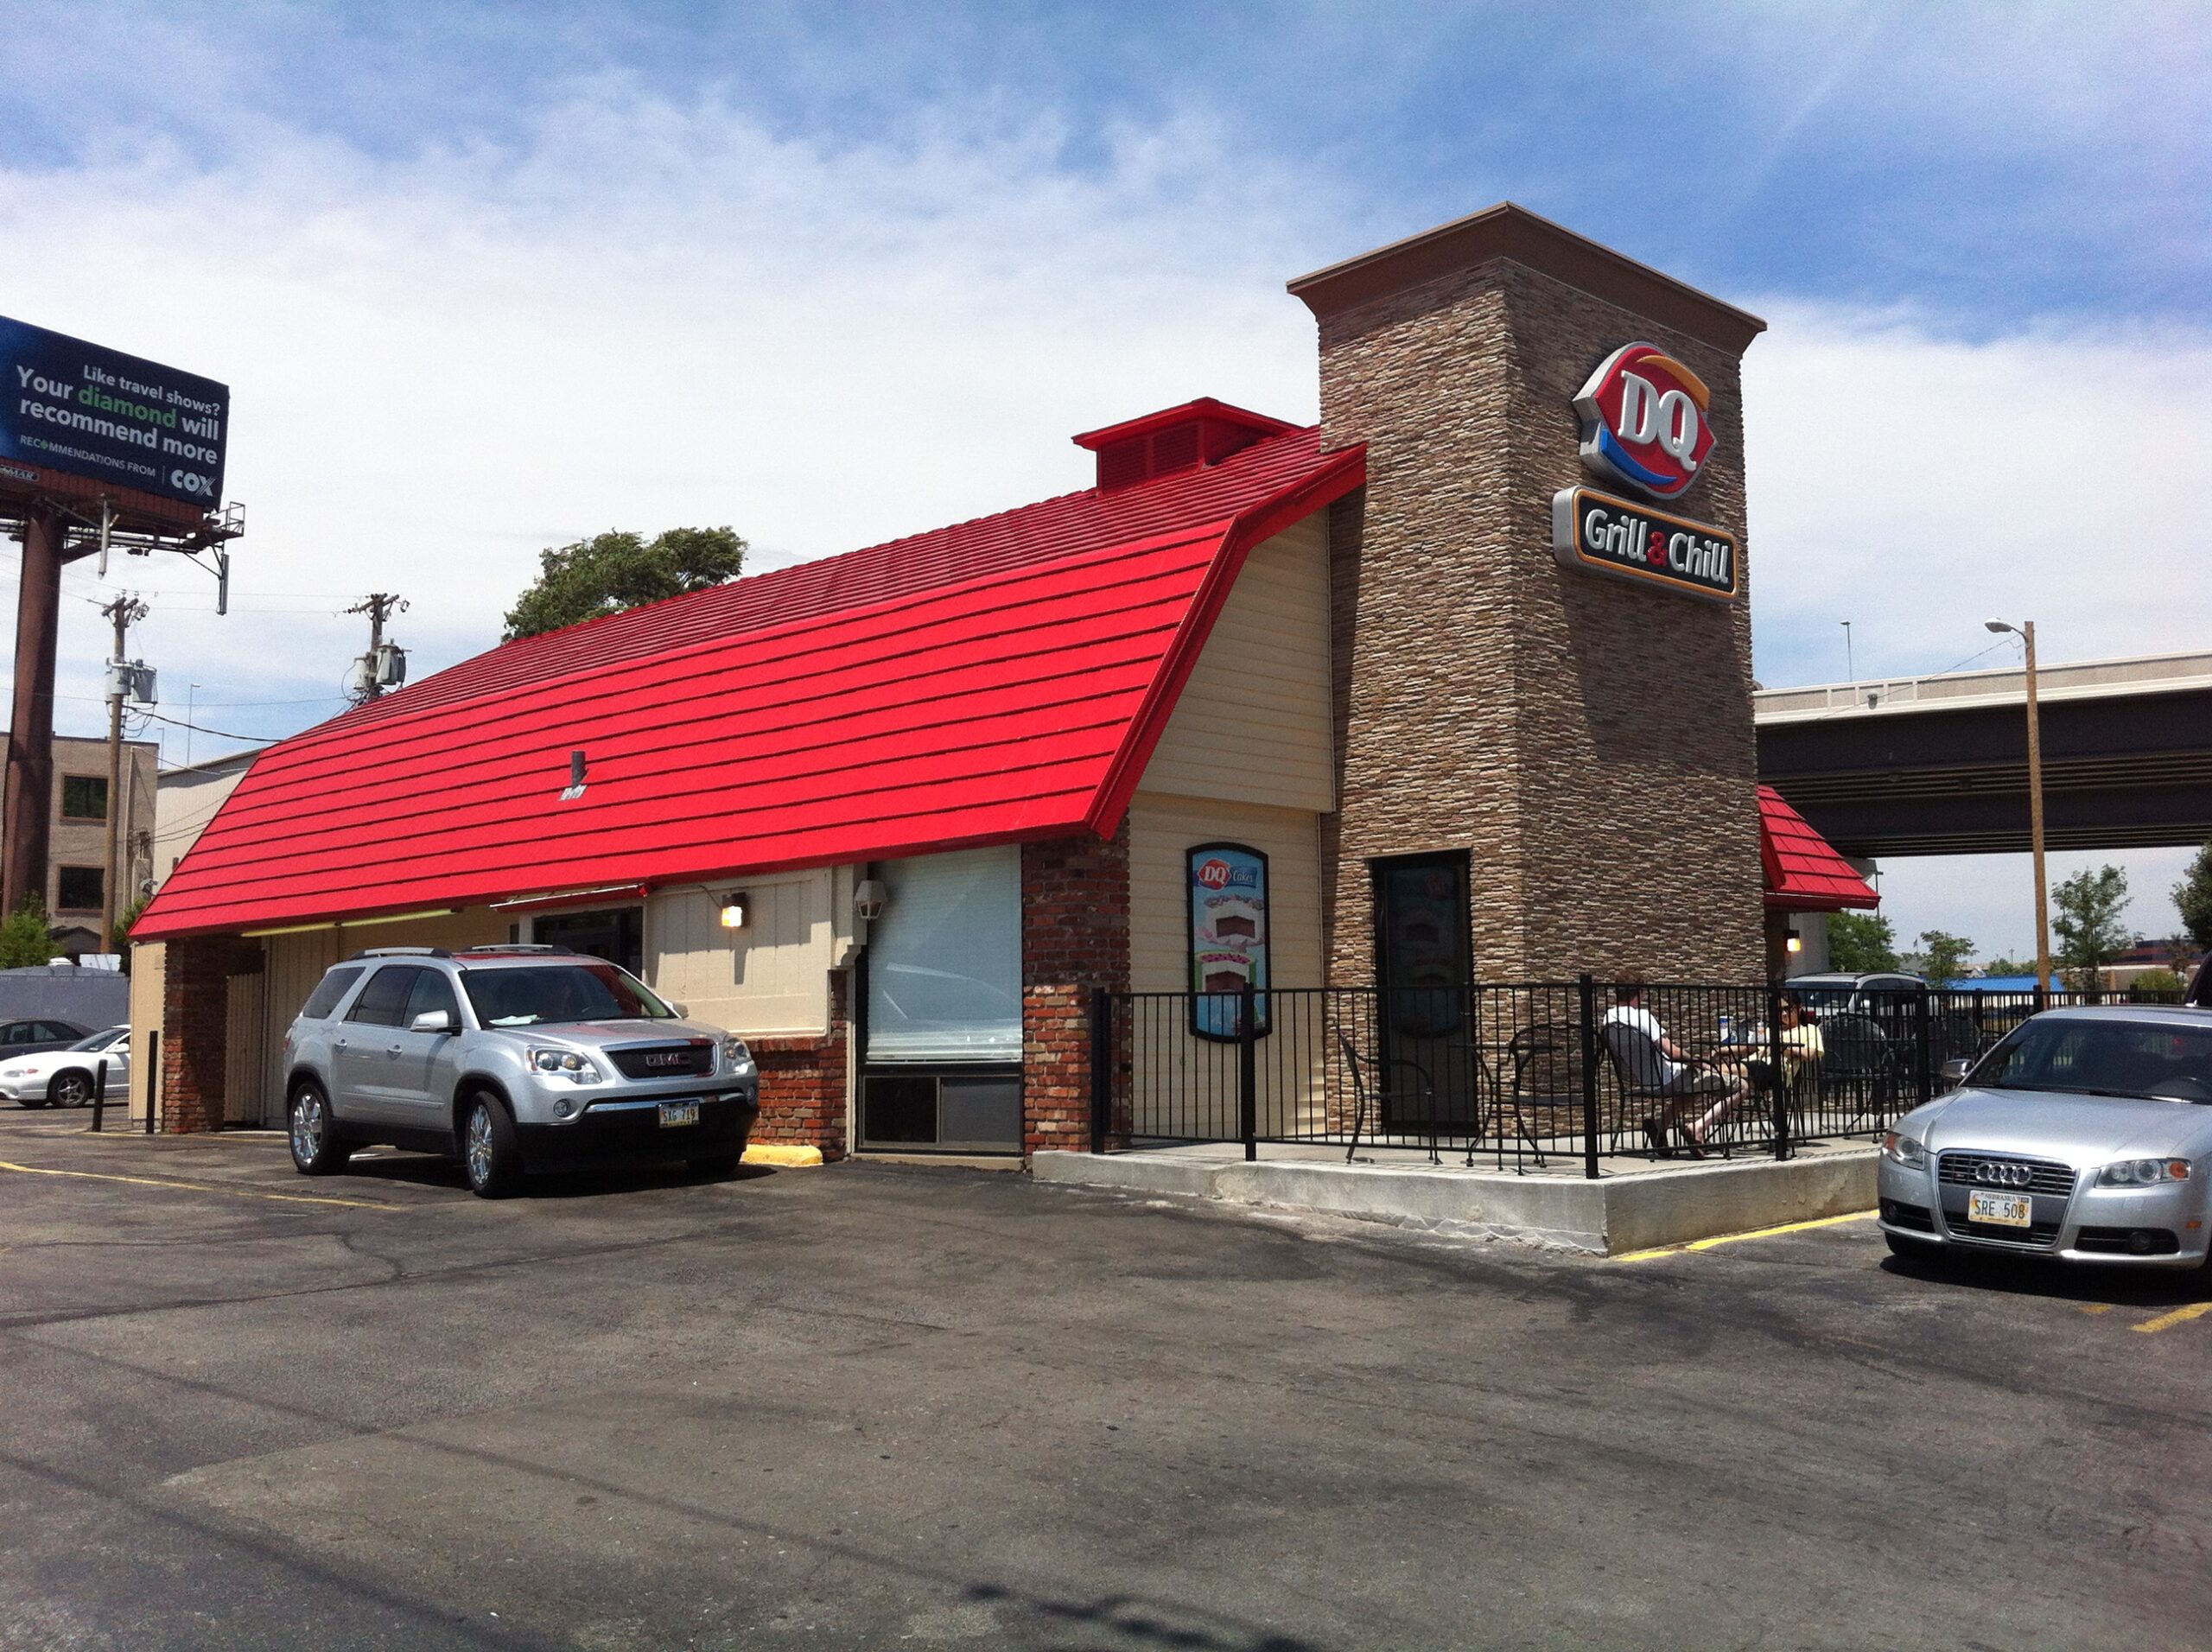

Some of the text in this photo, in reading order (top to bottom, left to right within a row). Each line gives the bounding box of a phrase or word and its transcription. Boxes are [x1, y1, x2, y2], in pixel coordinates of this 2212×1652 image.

[16, 365, 219, 441] Your diamond will
[83, 365, 220, 416] Like travel shows?
[20, 398, 218, 465] recommend more
[1618, 370, 1697, 472] DQ
[127, 461, 156, 478] FROM
[1204, 866, 1226, 884] DQ
[1974, 1199, 2025, 1219] SRE 508
